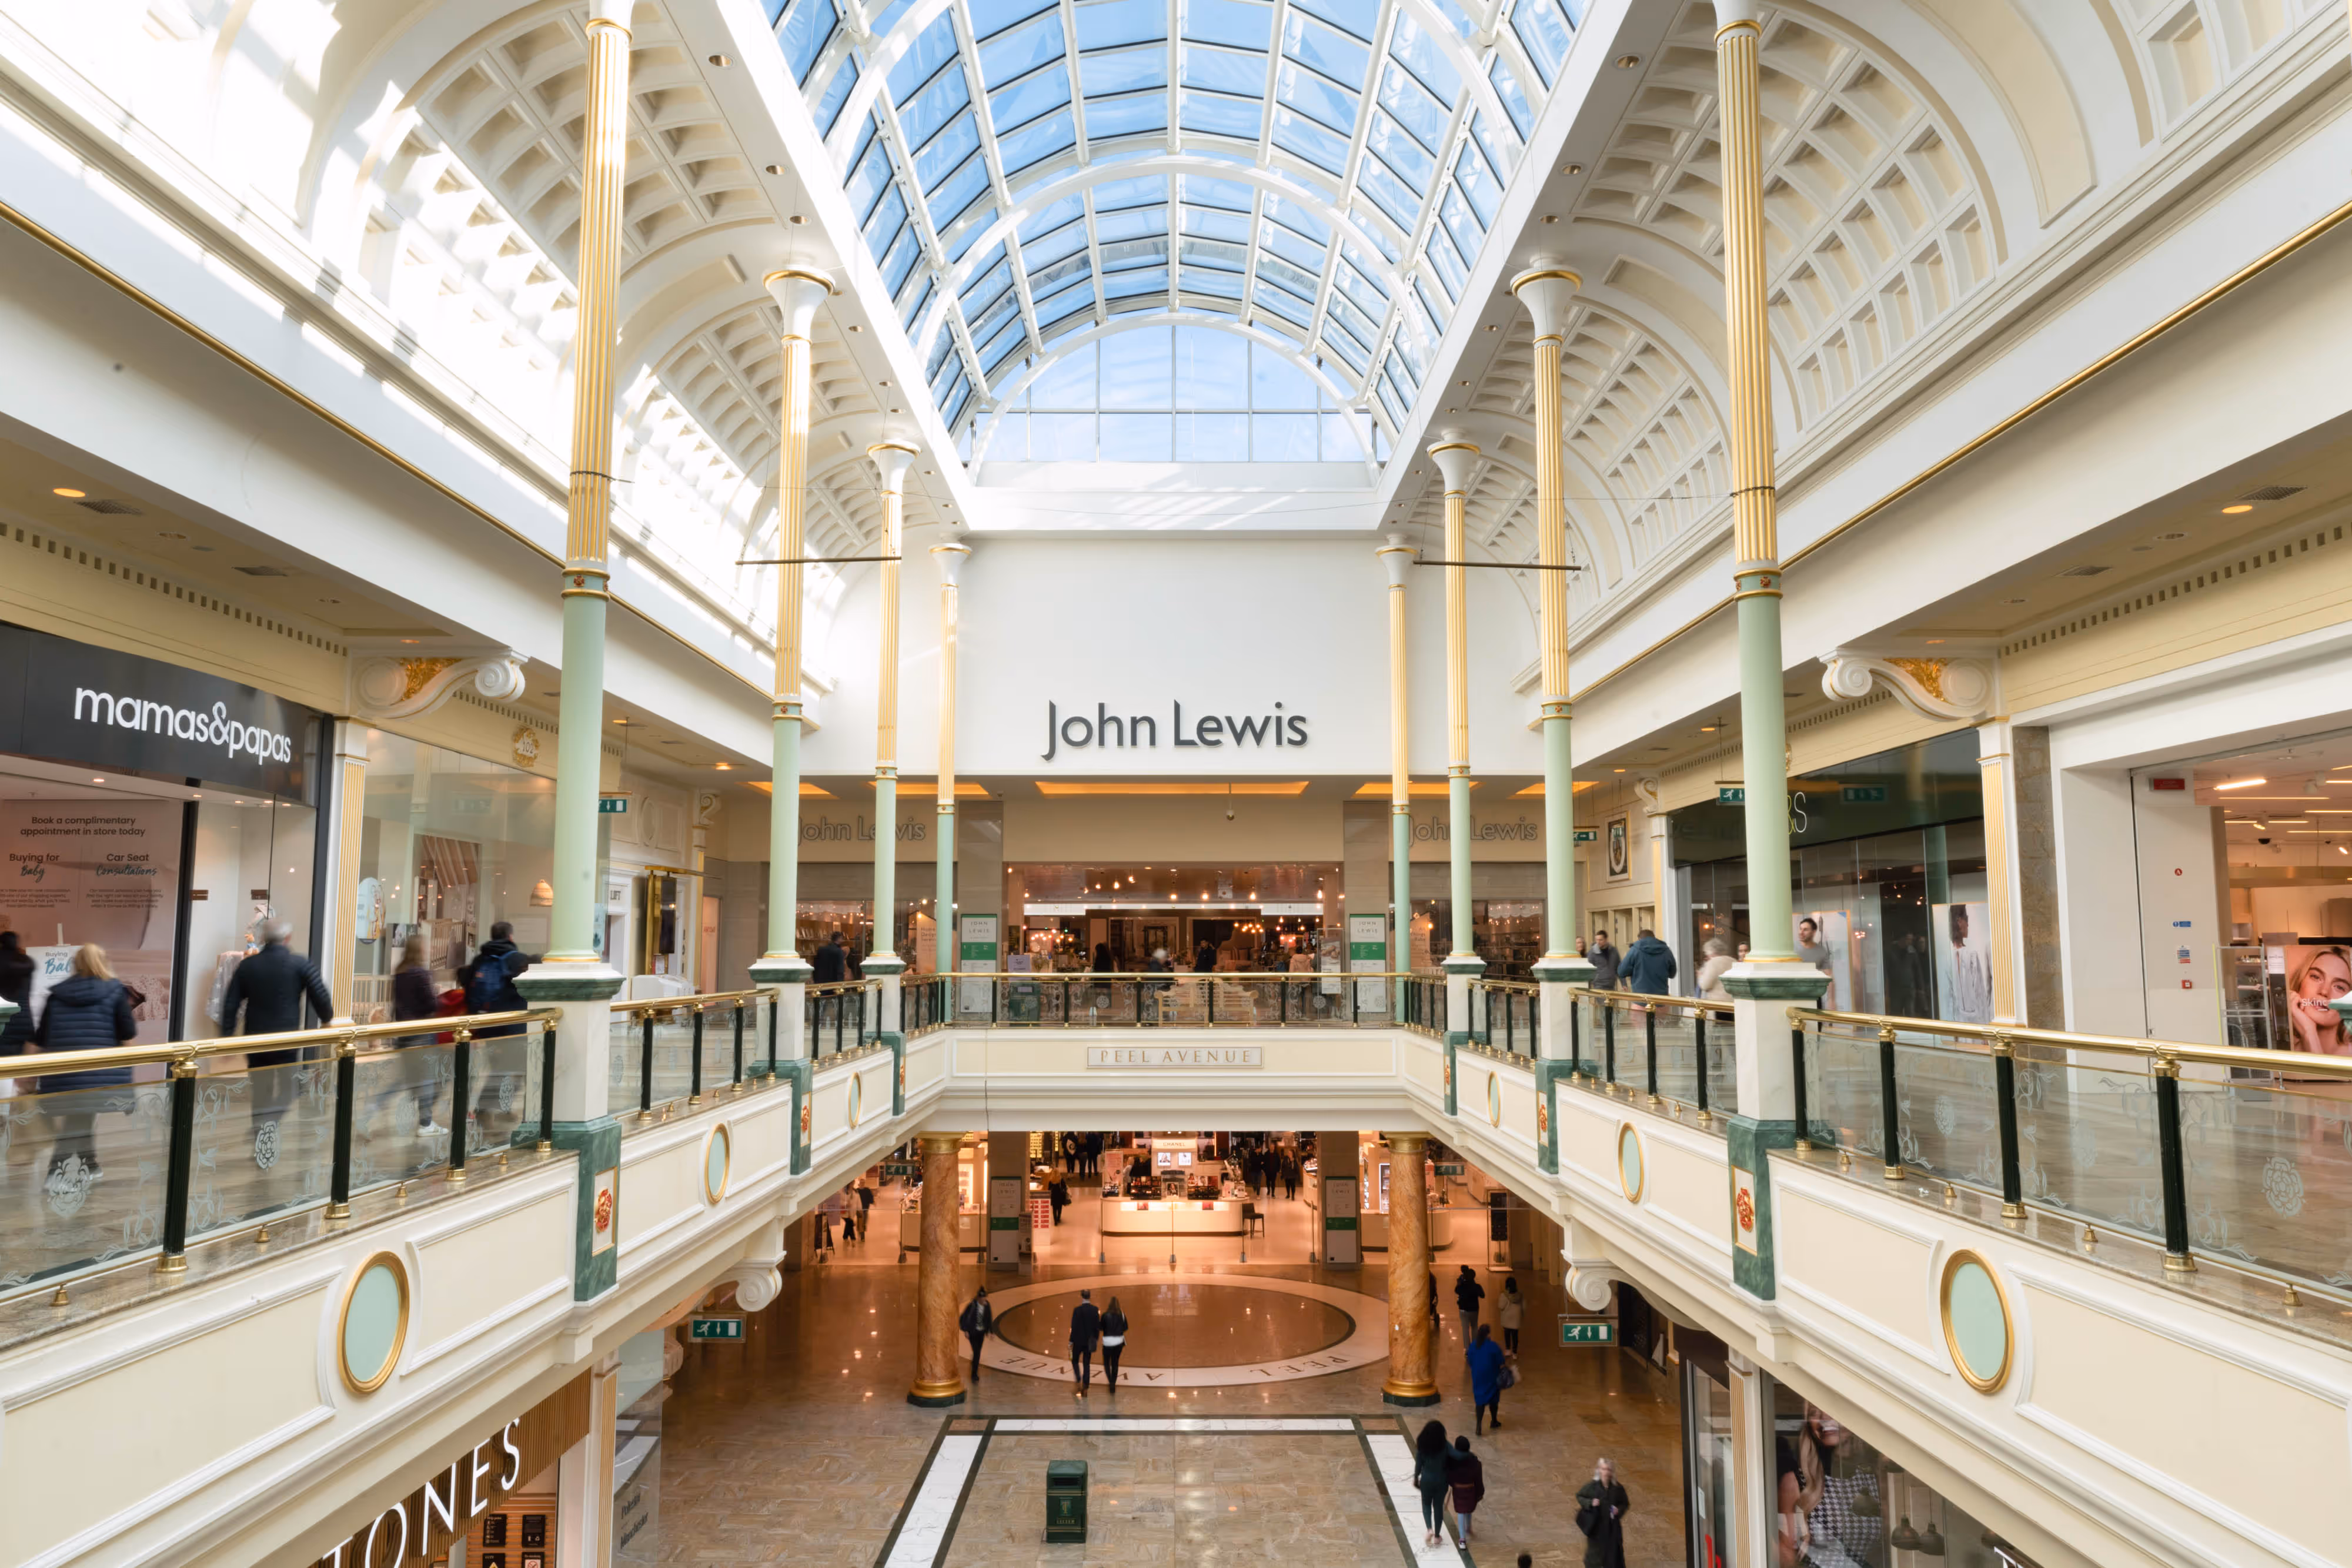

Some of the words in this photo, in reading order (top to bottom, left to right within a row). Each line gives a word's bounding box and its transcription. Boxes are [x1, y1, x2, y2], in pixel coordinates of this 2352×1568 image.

[74, 687, 291, 765] mamas&papas
[1040, 699, 1157, 762] John
[1174, 699, 1308, 748] Lewis
[65, 815, 136, 827] complimentary
[21, 828, 80, 837] appointment
[119, 827, 145, 837] today
[1409, 815, 1451, 847] Joh
[1470, 815, 1538, 841] Lewis
[9, 853, 43, 863] Buying
[46, 853, 60, 861] for
[20, 864, 45, 883] Baby
[95, 864, 158, 876] Consultations
[2301, 998, 2328, 1007] Skinc
[1101, 1050, 1150, 1063] PEEL
[1162, 1050, 1251, 1063] AVENUE
[1250, 1356, 1351, 1376] PEEL
